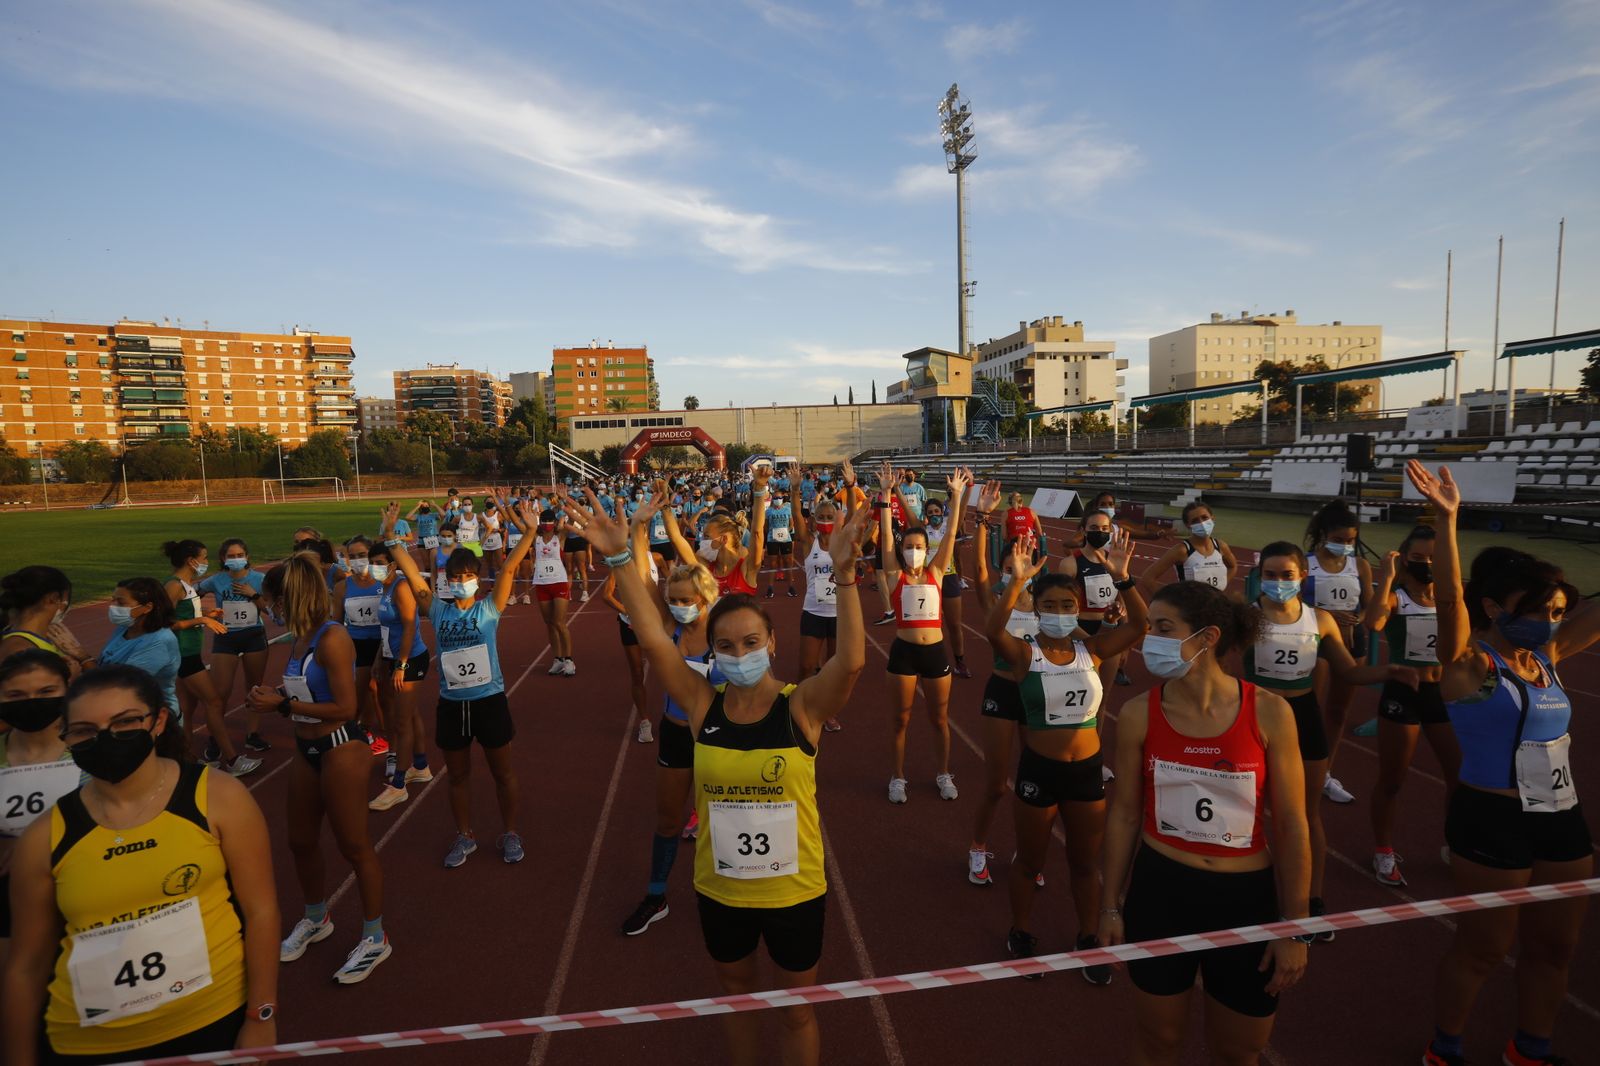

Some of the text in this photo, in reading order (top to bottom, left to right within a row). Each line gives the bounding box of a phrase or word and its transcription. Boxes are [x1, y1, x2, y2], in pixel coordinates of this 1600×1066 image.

[1099, 587, 1112, 598] 50
[1330, 588, 1347, 599] 10
[918, 598, 926, 609] 7
[234, 611, 247, 620] 15
[358, 607, 372, 617] 14
[1274, 649, 1298, 665] 25
[458, 662, 476, 676] 32
[1065, 689, 1087, 707] 27
[1170, 764, 1199, 775] CARRERA
[1551, 766, 1569, 790] 20
[703, 783, 784, 795] CLUB ATLETISMO
[6, 791, 44, 819] 26
[1195, 798, 1213, 822] 6
[737, 832, 770, 856] 33
[115, 951, 166, 987] 48
